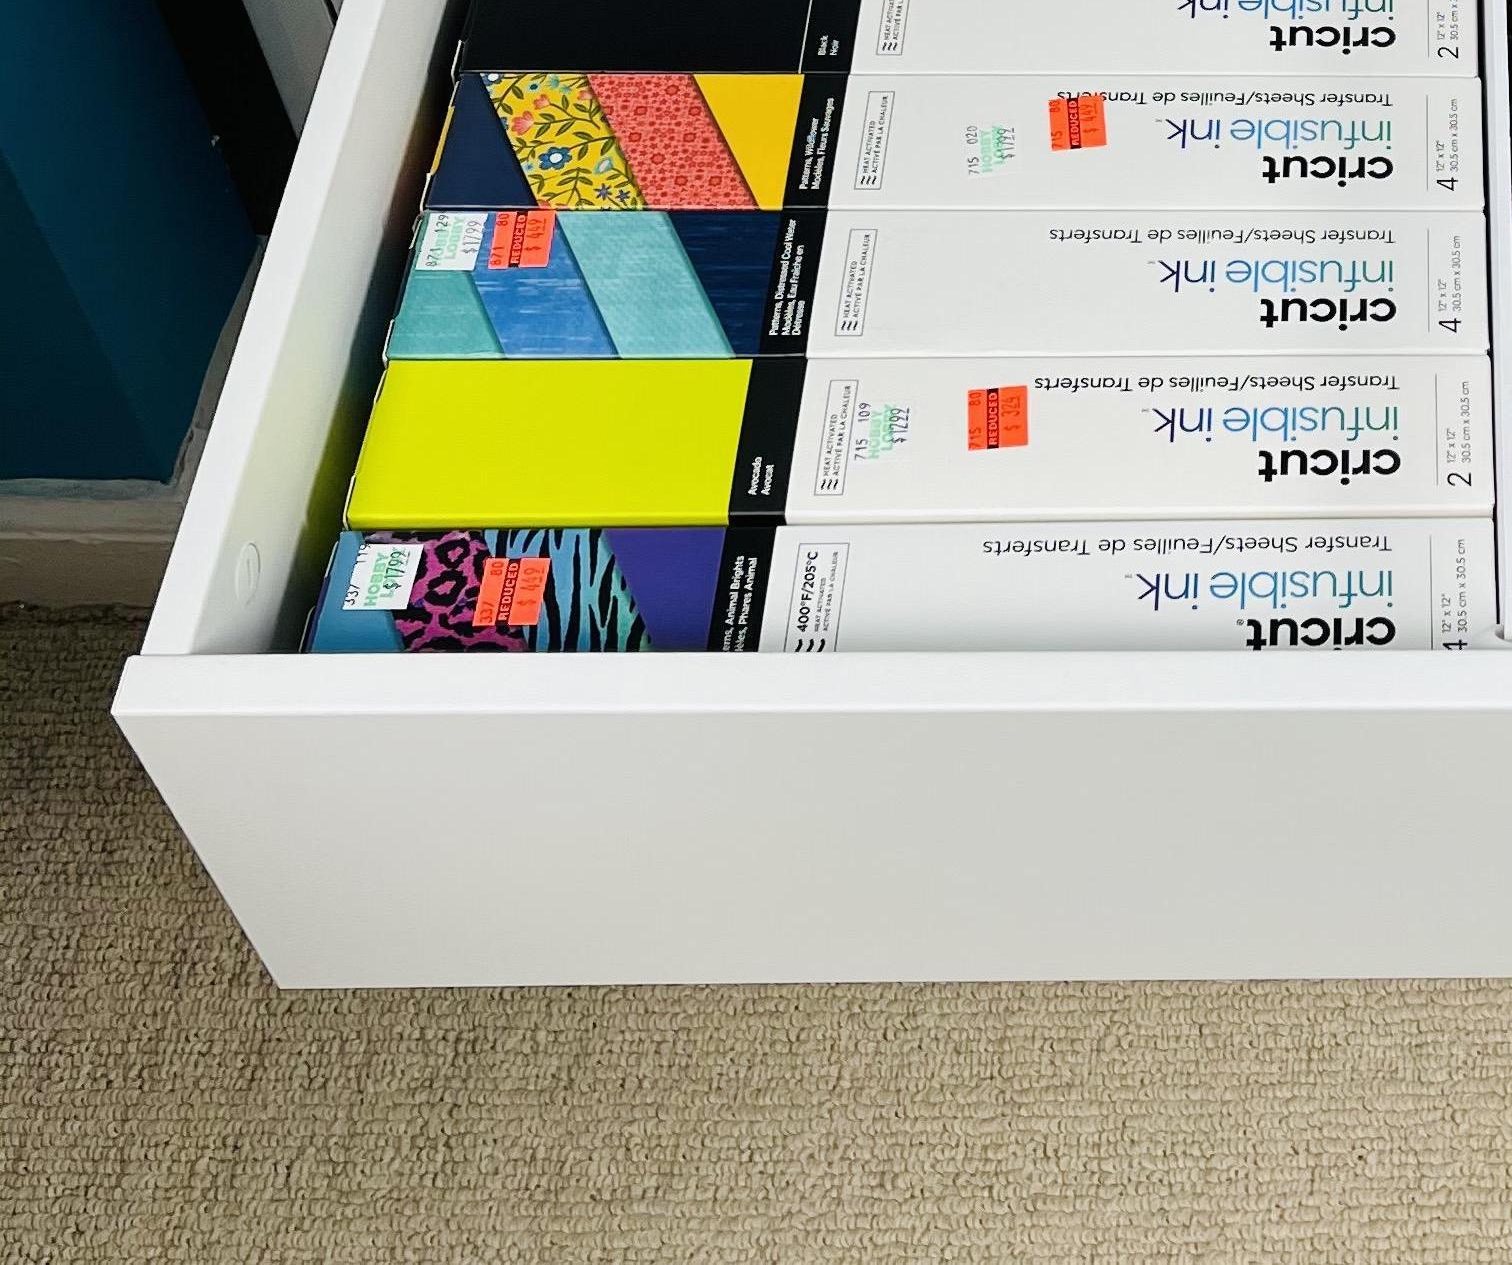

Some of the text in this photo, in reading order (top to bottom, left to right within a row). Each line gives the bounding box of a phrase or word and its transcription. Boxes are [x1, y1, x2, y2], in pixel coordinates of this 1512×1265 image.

[1269, 25, 1396, 55] cricut
[1437, 45, 1459, 59] 2
[1152, 91, 1392, 107] Transfer Sheets/Feuilles de
[1069, 101, 1080, 146] REDUCED
[1230, 118, 1392, 151] infusible
[966, 125, 980, 175] 715 020
[1262, 155, 1394, 188] cricut
[1436, 177, 1456, 191] 4
[435, 214, 450, 233] 129
[489, 213, 510, 266] 871 80
[510, 214, 527, 265] REDUCED
[1049, 228, 1396, 244] Transfer Sheets/Feuilles de Transferts
[1225, 260, 1394, 293] infusible
[1260, 298, 1397, 332] cricut
[1438, 318, 1462, 334] 4
[1034, 374, 1399, 391] Transfer Sheets/Feuilles de Transferts
[854, 402, 871, 461] 715 109
[987, 392, 999, 447] REDUCED
[1223, 407, 1399, 442] infusible
[748, 457, 763, 496] Avocado
[761, 464, 775, 496] Avocat
[1258, 448, 1401, 485] cricut
[1446, 470, 1472, 488] 2
[982, 536, 1393, 555] Transfer Sheets/Feuilles de Transferts
[1458, 538, 1466, 555] cm
[363, 552, 391, 607] HOBBY
[730, 555, 745, 590] Brights
[1210, 570, 1394, 609] infusible
[479, 561, 505, 624] 337 80
[497, 562, 520, 622] REDUCED
[738, 557, 758, 625] Phares Animal
[796, 550, 819, 633] 400°F/205°C
[1459, 591, 1467, 608] cm
[1246, 616, 1397, 650] cricut
